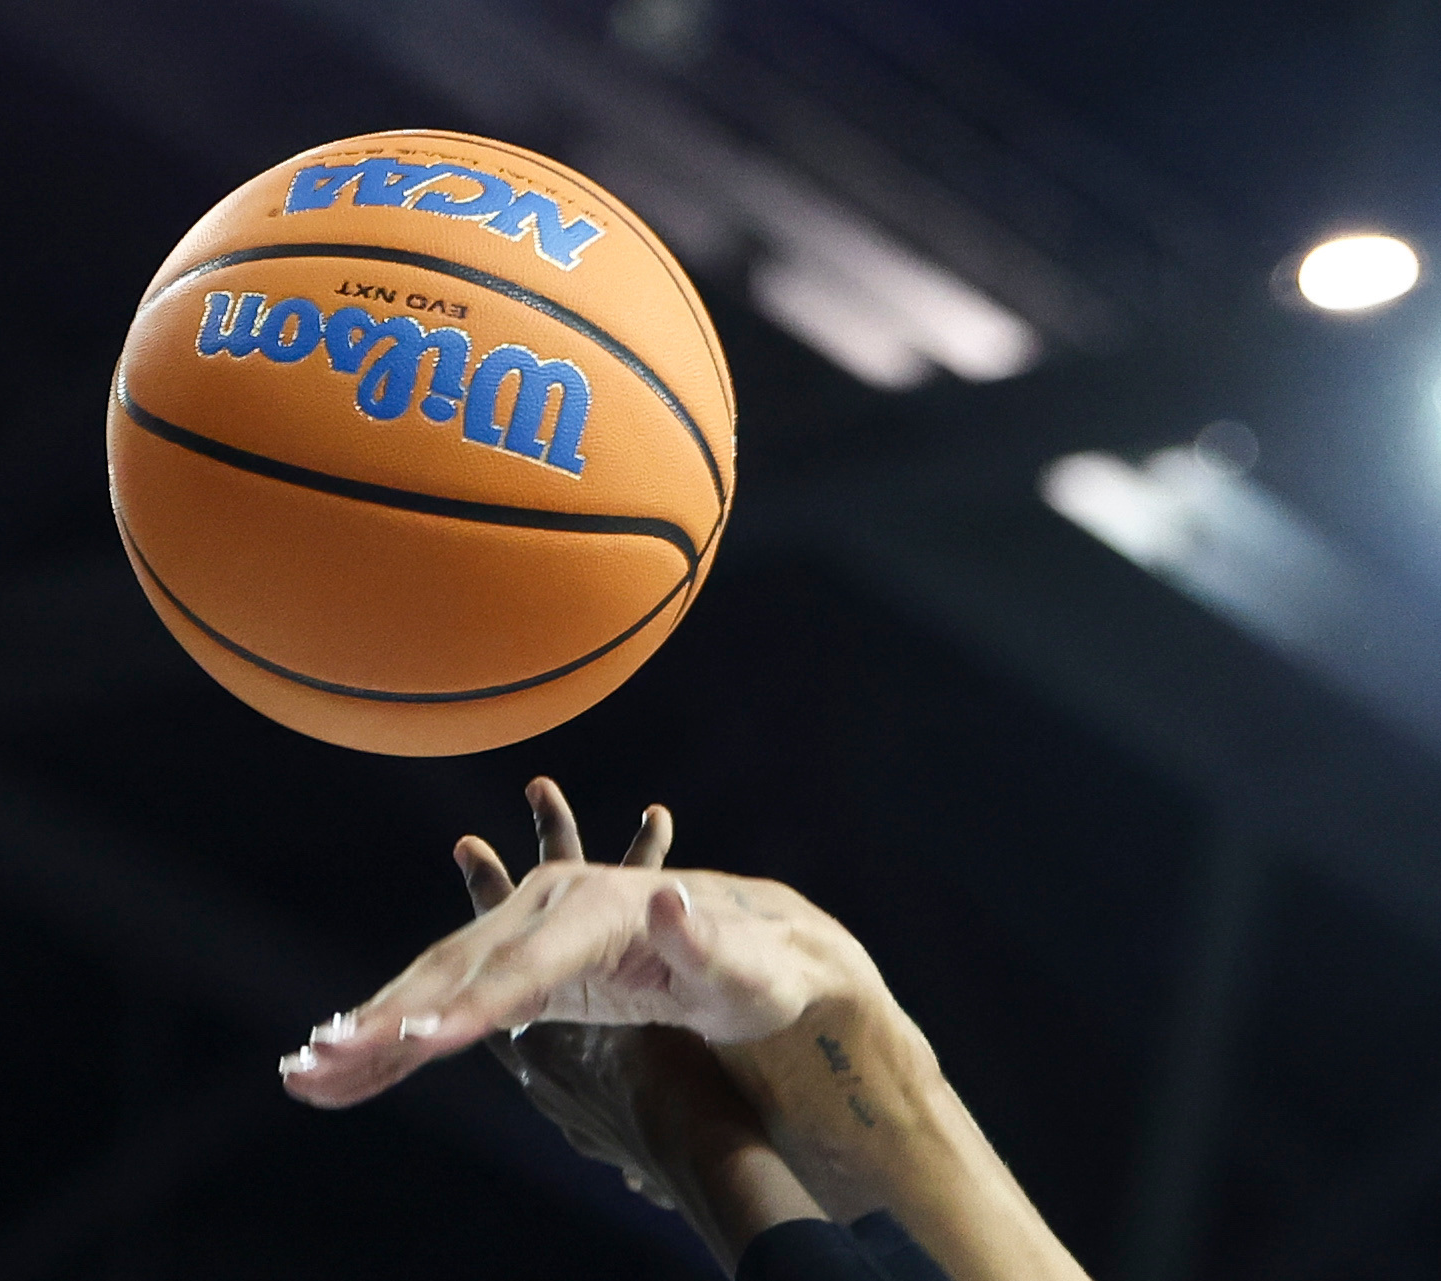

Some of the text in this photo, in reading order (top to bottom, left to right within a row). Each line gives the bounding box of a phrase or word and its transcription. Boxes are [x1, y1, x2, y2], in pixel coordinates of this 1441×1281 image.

[283, 157, 607, 271] NCAA
[334, 281, 468, 321] EVO NXT
[195, 291, 592, 480] Wilson
